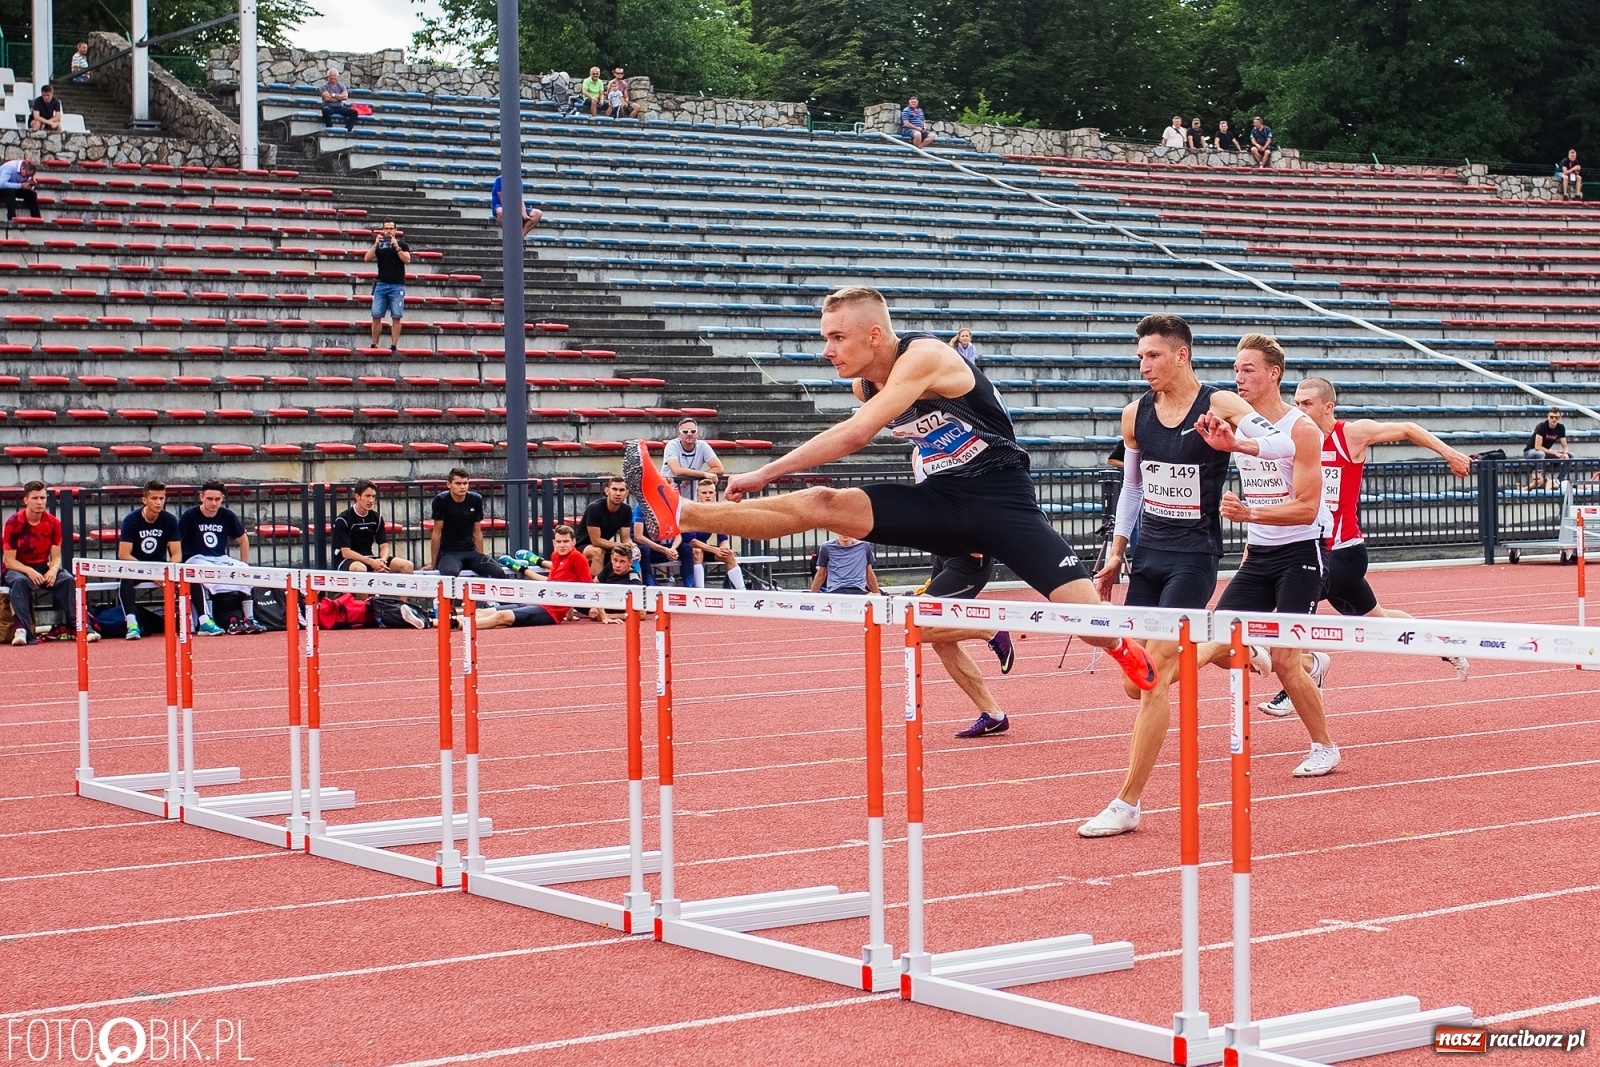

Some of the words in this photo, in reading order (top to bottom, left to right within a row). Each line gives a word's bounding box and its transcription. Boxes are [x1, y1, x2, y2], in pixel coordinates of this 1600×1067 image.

[916, 414, 945, 434] 672
[962, 446, 979, 461] 2019
[1145, 463, 1161, 474] 4F
[1169, 466, 1196, 479] 149
[1259, 461, 1278, 472] 193
[1243, 479, 1284, 488] JANOWSKI
[1148, 483, 1193, 498] DEJNEKO
[1326, 485, 1338, 495] SKI
[1176, 510, 1192, 518] 2019
[199, 524, 224, 532] UMCS
[139, 529, 163, 539] UMCS
[753, 599, 765, 610] 4F
[966, 607, 990, 618] ORLEN
[1030, 610, 1044, 623] 4F
[1090, 619, 1110, 627] 4MOVE
[1312, 628, 1342, 640] ORLEN
[1397, 631, 1416, 645] 4F
[1479, 640, 1507, 649] 4MOVE
